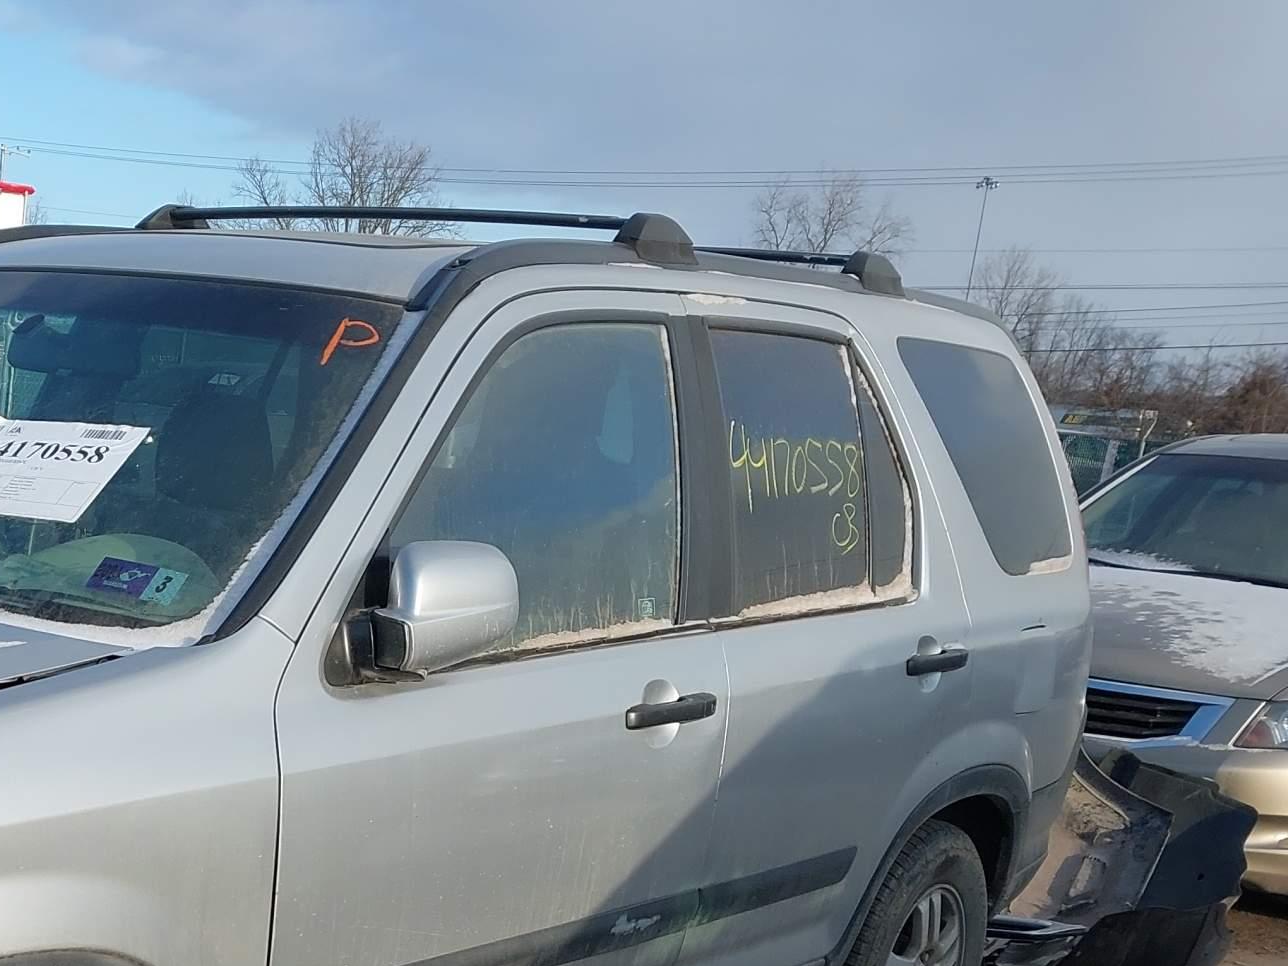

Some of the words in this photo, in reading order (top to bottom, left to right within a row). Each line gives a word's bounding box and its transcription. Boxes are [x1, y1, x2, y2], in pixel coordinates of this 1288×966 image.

[320, 318, 380, 366] P
[728, 419, 861, 514] 44170558
[154, 575, 174, 594] 3
